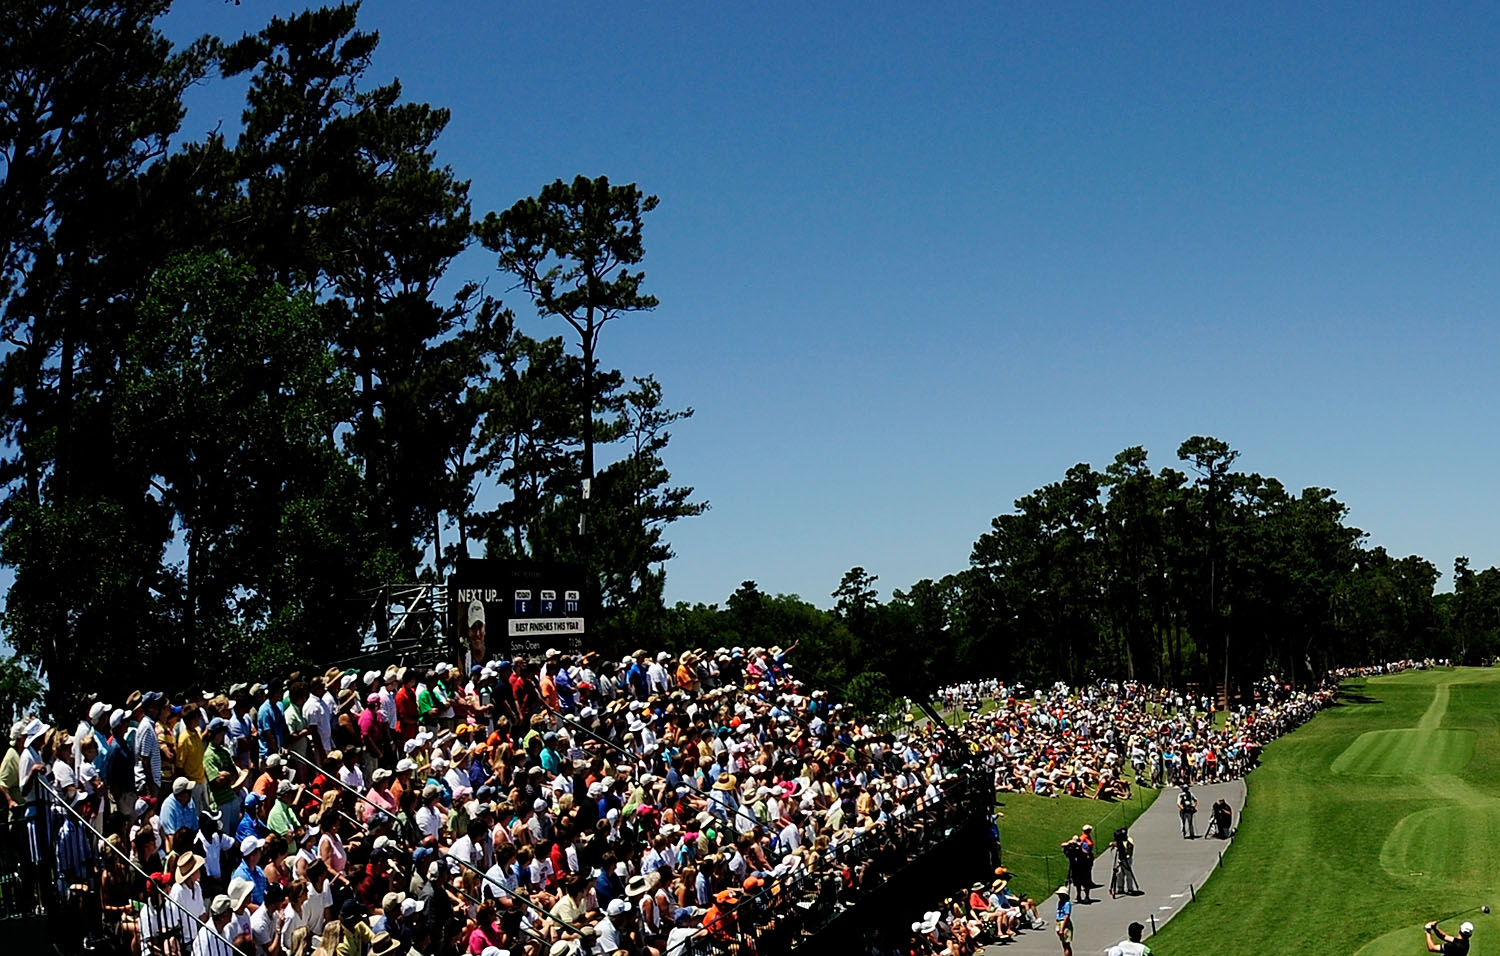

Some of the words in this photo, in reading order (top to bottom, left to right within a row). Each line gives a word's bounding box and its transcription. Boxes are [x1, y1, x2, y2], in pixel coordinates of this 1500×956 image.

[458, 589, 482, 603] NEXT
[515, 622, 529, 632] BEST
[529, 622, 553, 632] FINISHES
[554, 622, 566, 631] THIS
[566, 621, 579, 630] YEAR
